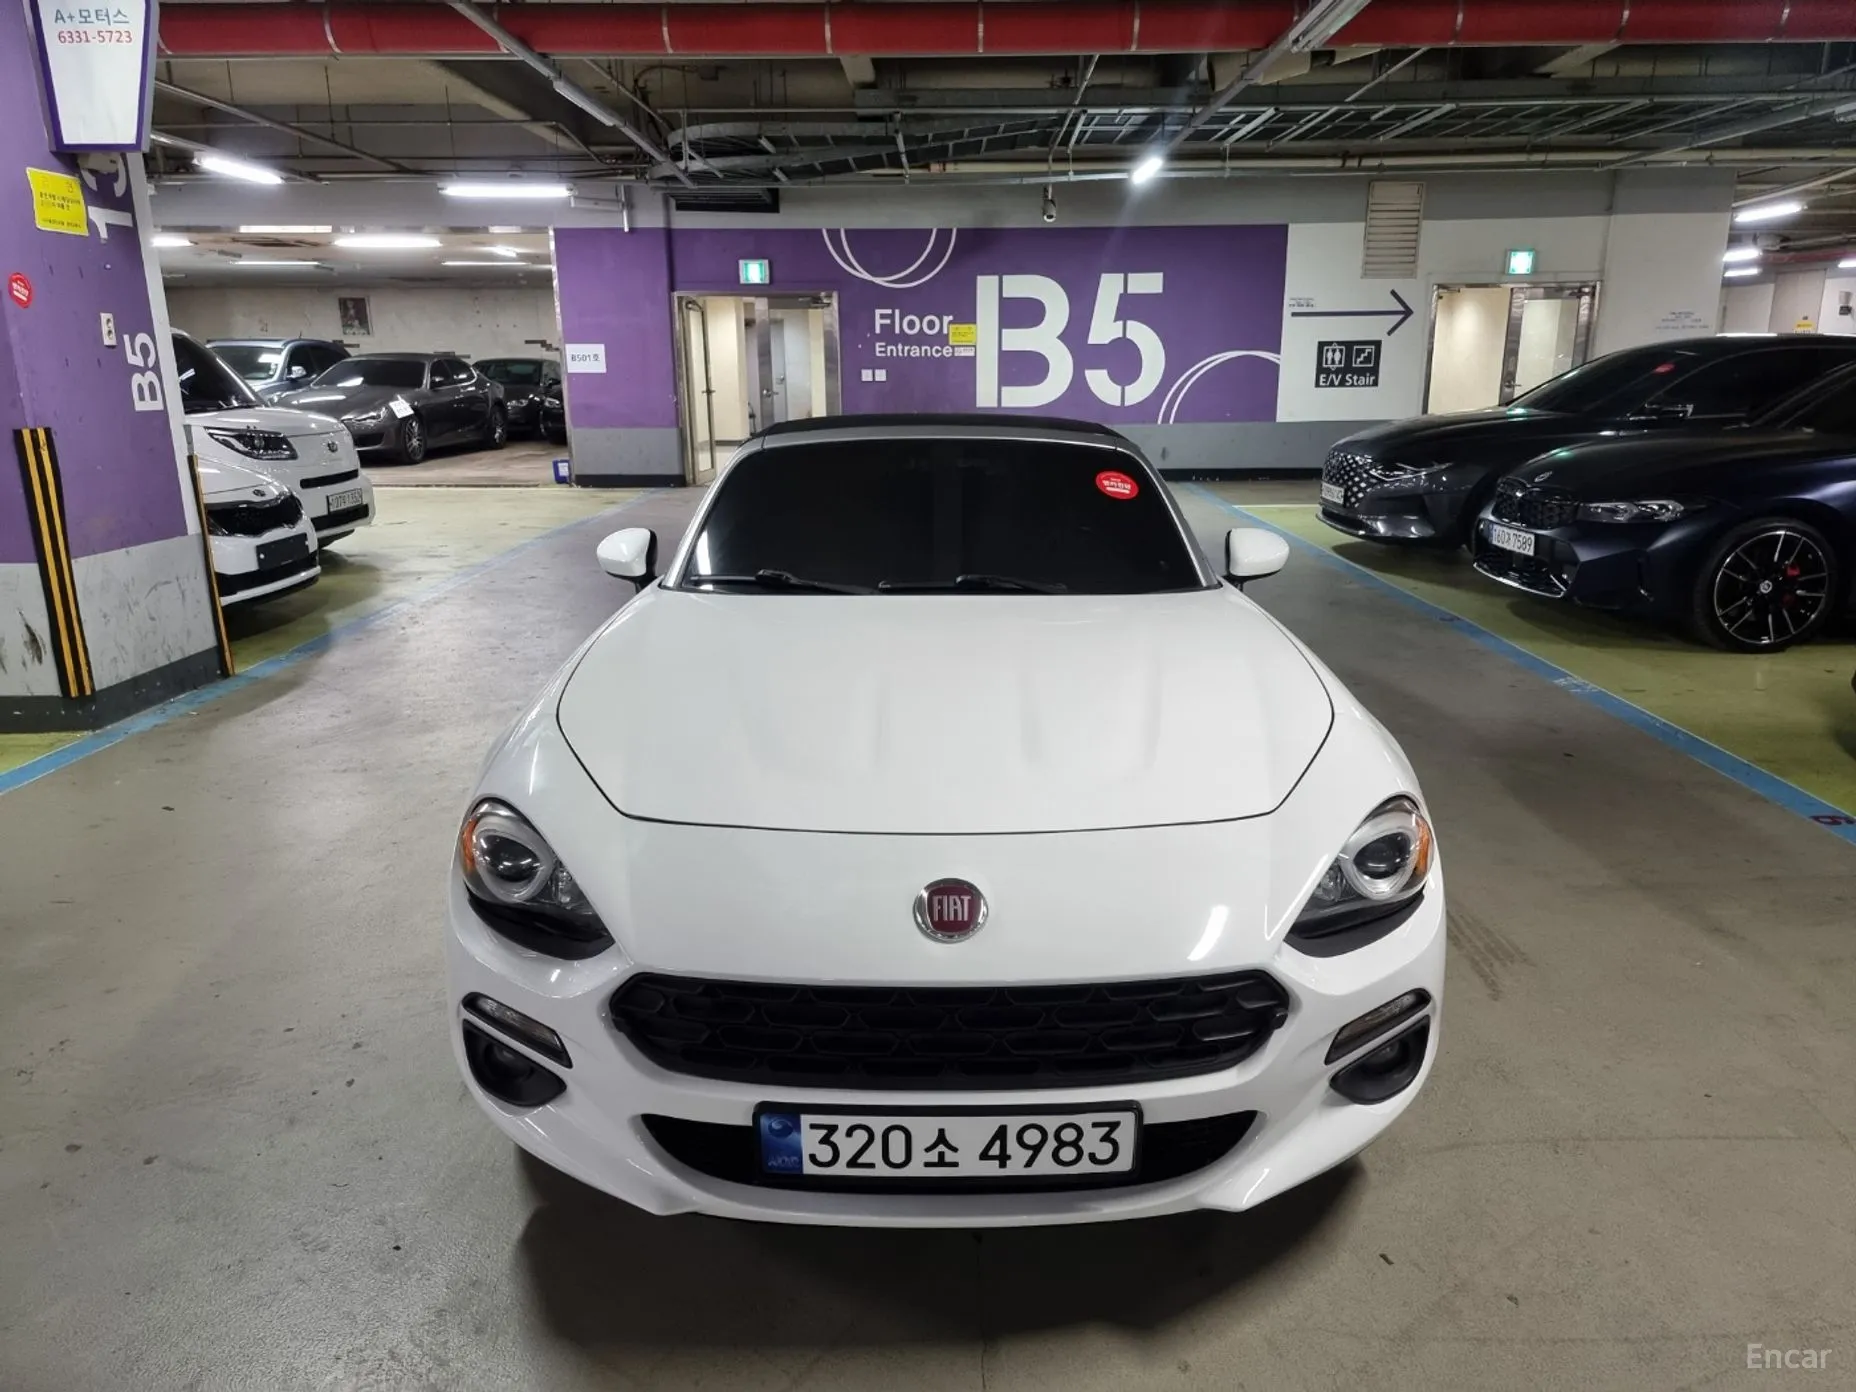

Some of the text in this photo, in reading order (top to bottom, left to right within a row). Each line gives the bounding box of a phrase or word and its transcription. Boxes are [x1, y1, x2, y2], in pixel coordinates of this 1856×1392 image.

[54, 8, 130, 25] A+모터스
[58, 30, 133, 44] 6331-5723
[874, 308, 954, 335] Floor
[875, 342, 953, 357] Entrance
[976, 271, 1166, 408] B5
[571, 353, 601, 362] B501호
[123, 332, 165, 411] B5
[1319, 372, 1376, 386] E/V Stair
[932, 895, 972, 922] FIAT
[807, 1120, 1122, 1169] 320소 4983
